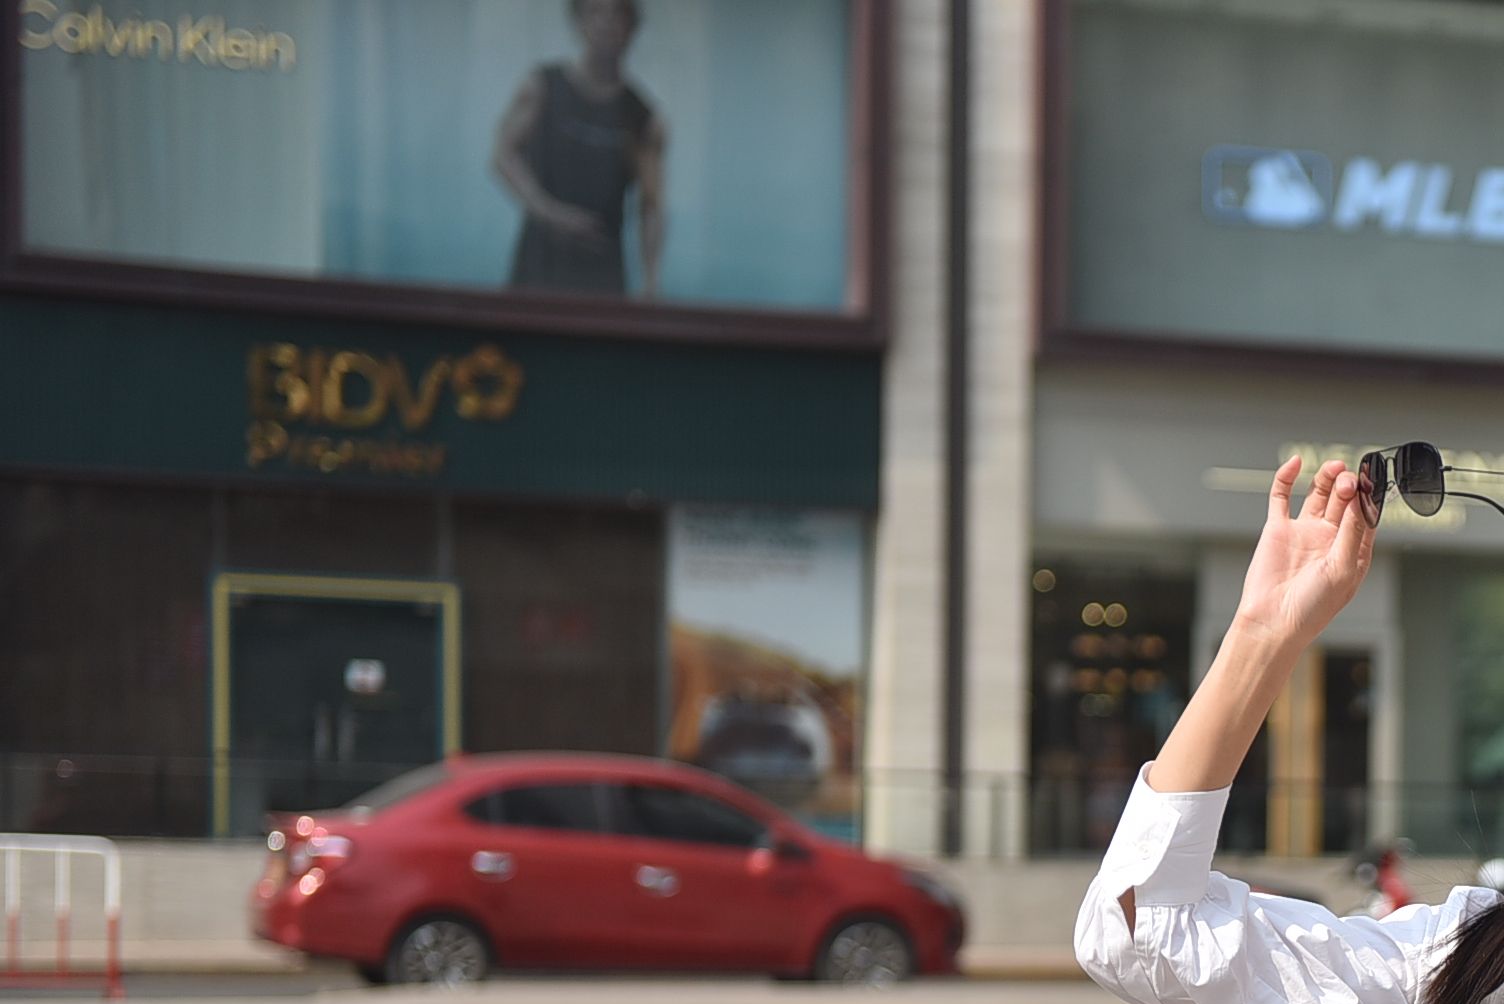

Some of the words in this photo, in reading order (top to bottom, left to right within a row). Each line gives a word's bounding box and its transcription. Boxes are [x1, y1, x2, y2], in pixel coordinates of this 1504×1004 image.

[18, 0, 173, 59] Calvin
[177, 12, 296, 71] Klein
[249, 343, 448, 427] BIDV
